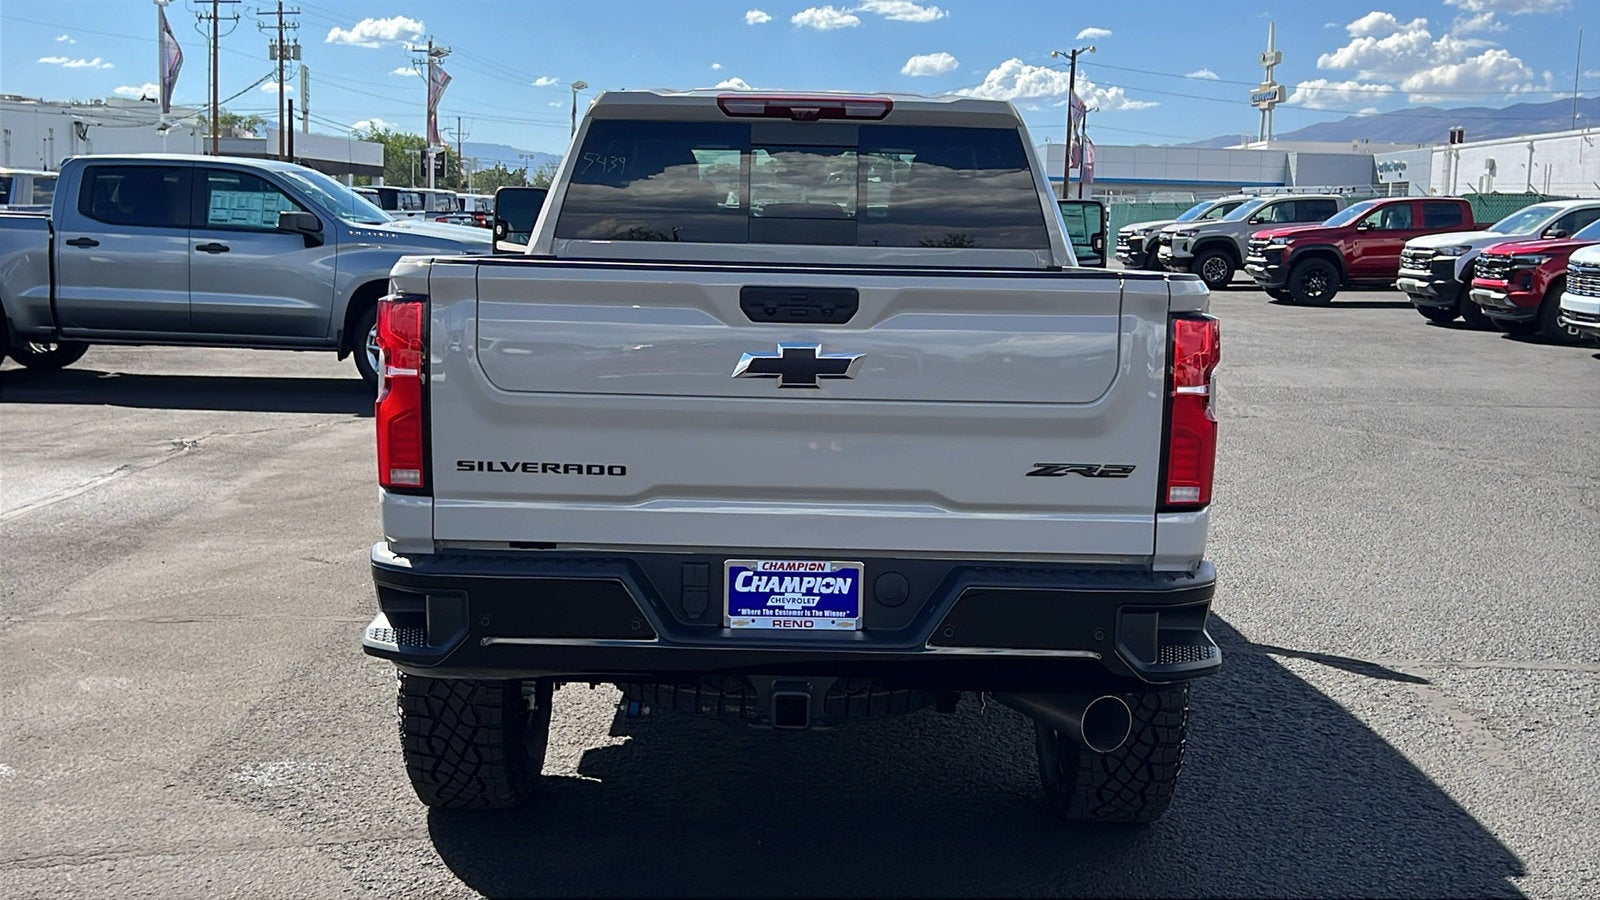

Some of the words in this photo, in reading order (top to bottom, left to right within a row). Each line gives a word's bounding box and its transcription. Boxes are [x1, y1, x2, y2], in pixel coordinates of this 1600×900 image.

[580, 152, 626, 176] 5439
[456, 460, 627, 476] SILVERADO
[1025, 463, 1137, 478] ZR2
[762, 562, 826, 571] CHAMPION
[735, 571, 851, 594] CHAMPION
[770, 597, 816, 605] CHEVROLET
[762, 608, 774, 616] The
[774, 609, 804, 617] Customer
[811, 609, 823, 617] The
[772, 619, 814, 628] RENO
